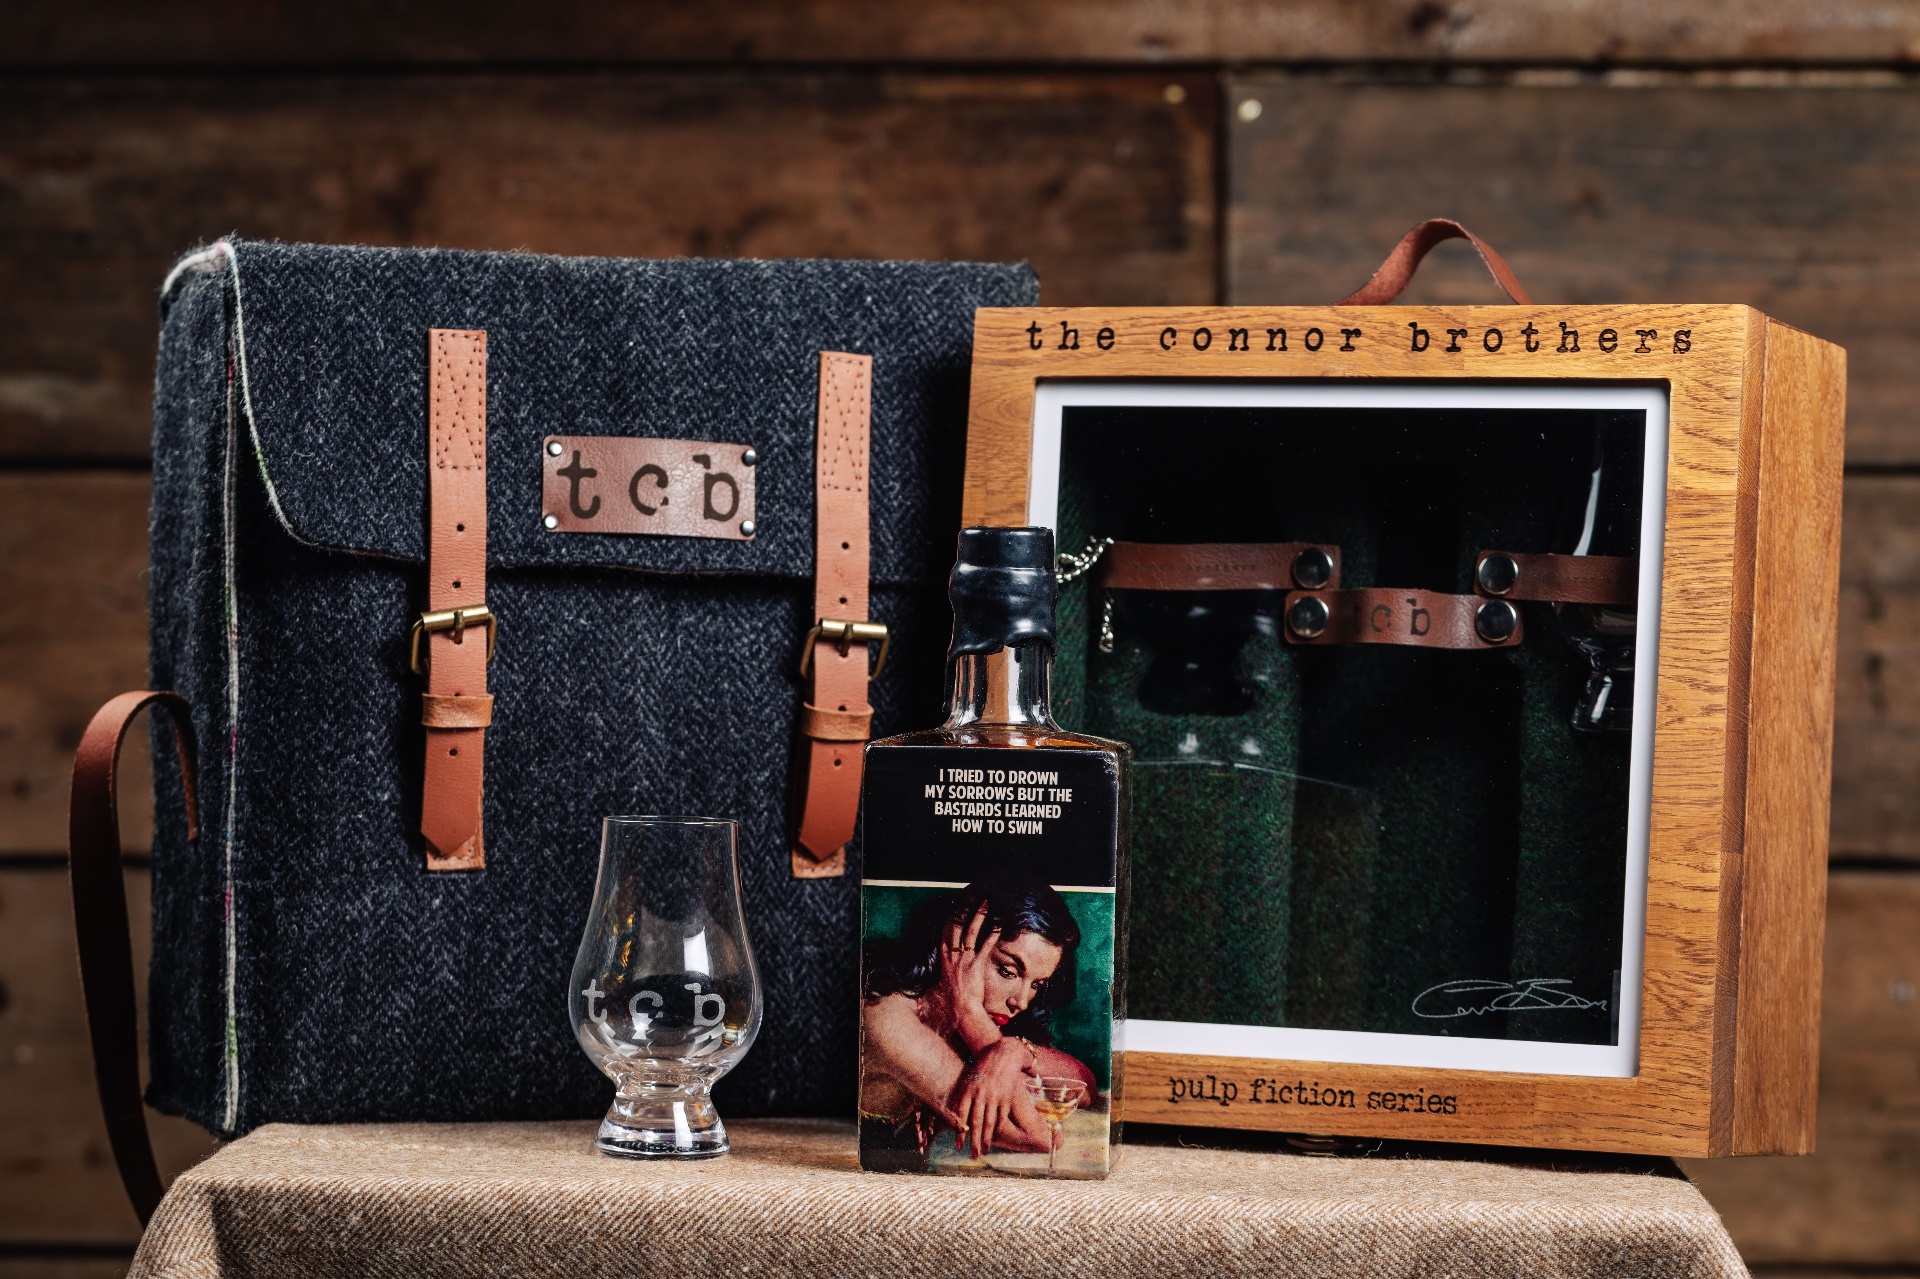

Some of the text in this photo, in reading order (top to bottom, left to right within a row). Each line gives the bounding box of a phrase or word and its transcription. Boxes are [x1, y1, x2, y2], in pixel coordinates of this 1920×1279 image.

[1025, 320, 1692, 354] the connor brothers
[939, 768, 1059, 786] I TRIED TO DROWN
[924, 784, 1073, 803] MY SORROWS BUT THE
[934, 801, 1062, 819] BASTARDS LEARNED
[951, 818, 1043, 835] HOW TO SWIM
[1168, 1075, 1458, 1115] pulp fiction series
